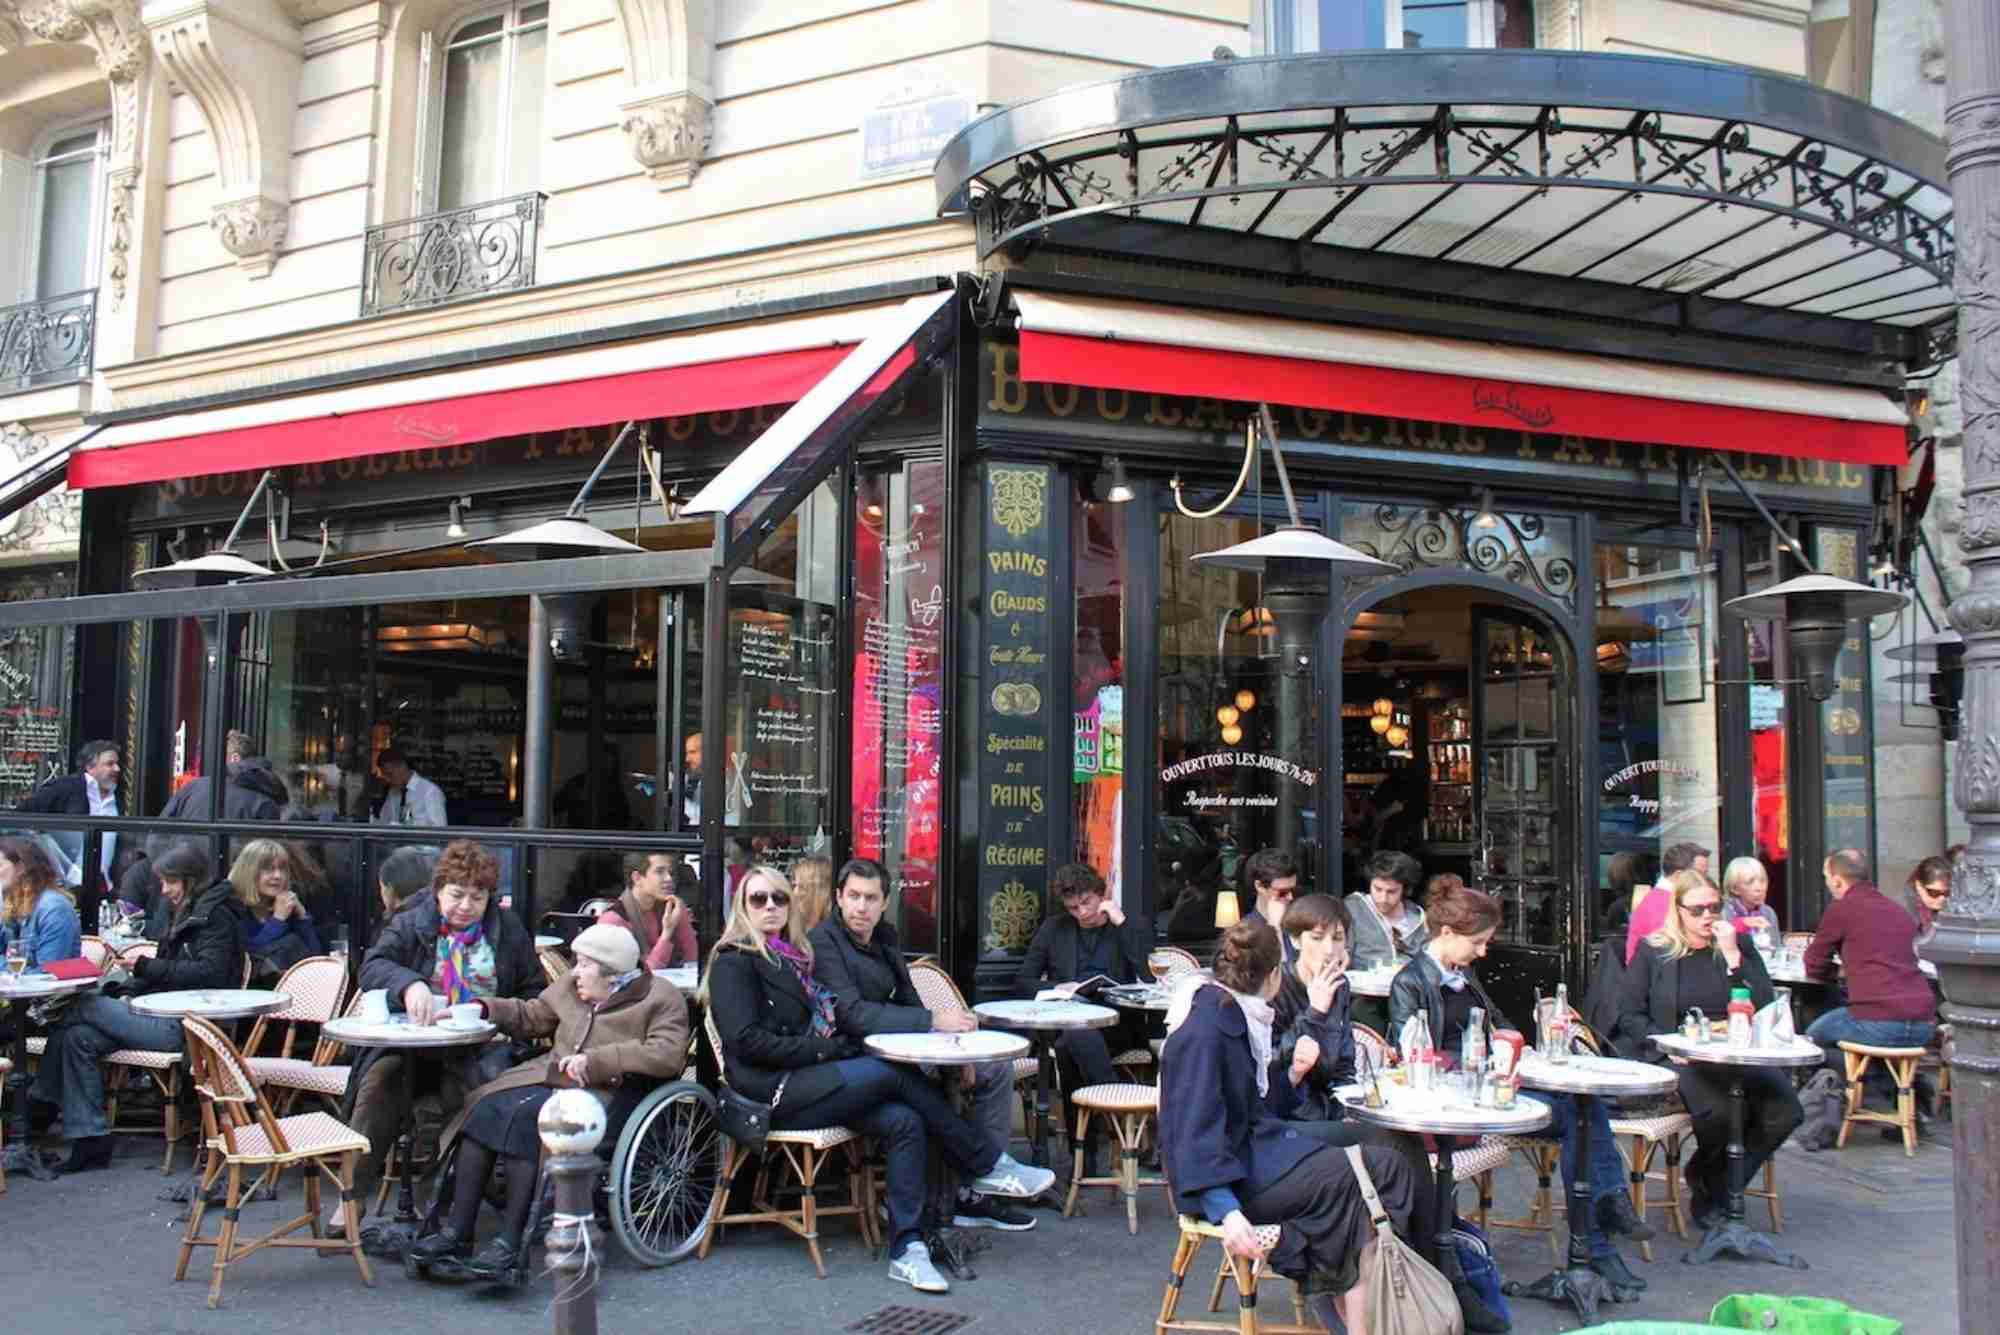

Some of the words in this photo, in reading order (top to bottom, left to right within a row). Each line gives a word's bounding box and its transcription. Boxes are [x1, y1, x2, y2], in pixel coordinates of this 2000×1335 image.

[988, 551, 1048, 577] PAINS
[1162, 757, 1207, 782] OUVERT
[1206, 752, 1234, 768] TOUS
[1236, 752, 1256, 766] LES
[1255, 754, 1289, 774] JOURS
[991, 784, 1044, 813] PAINS
